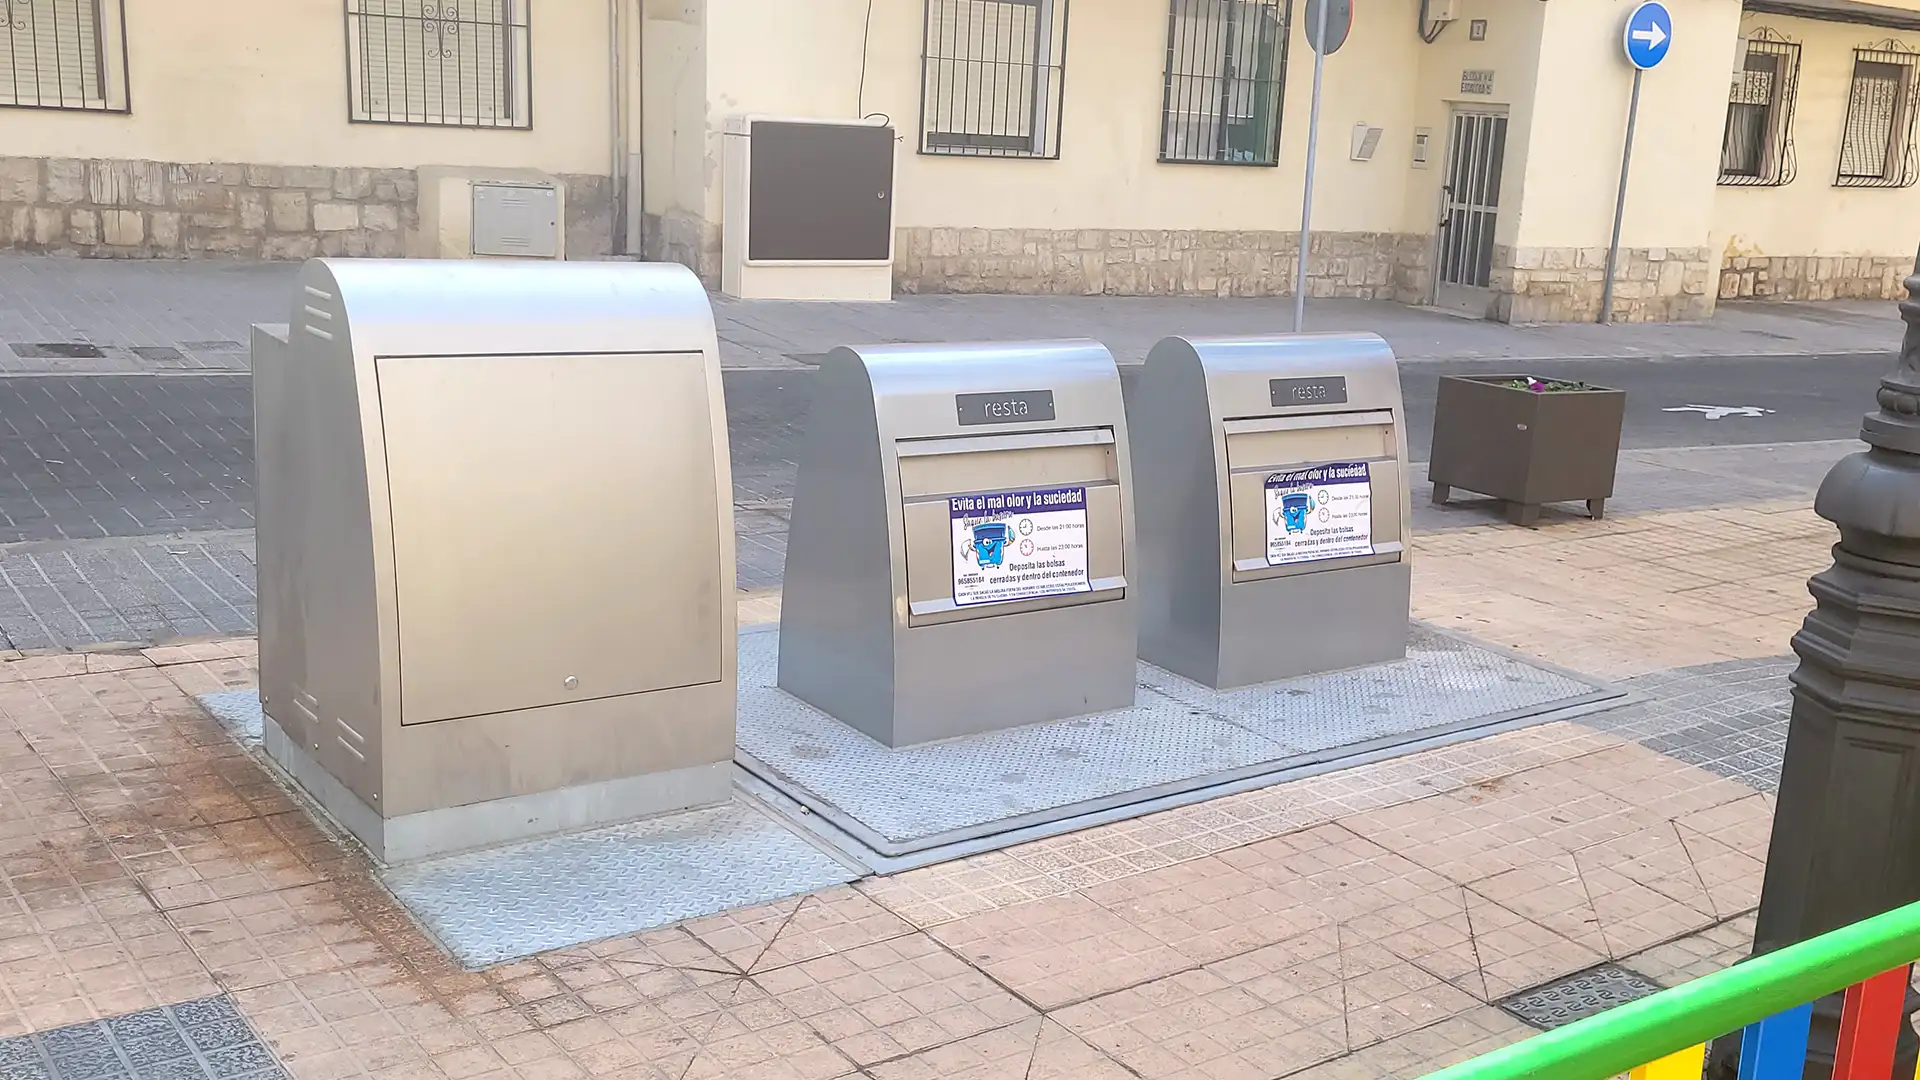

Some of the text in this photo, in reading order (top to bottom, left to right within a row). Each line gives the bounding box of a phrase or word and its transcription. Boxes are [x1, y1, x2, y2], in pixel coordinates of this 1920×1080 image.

[1292, 385, 1326, 400] resta
[985, 399, 1028, 417] resta
[1308, 468, 1322, 480] olor
[1323, 469, 1328, 482] y
[1328, 466, 1336, 478] la
[1336, 463, 1367, 478] suciedad
[952, 489, 1082, 511] Evita el mal olor y la suciedad
[1310, 528, 1330, 536] Deposita
[1009, 559, 1066, 572] Deposita las bolsas
[989, 573, 1017, 583] cerradas
[1016, 574, 1021, 583] y
[1021, 572, 1041, 581] dentro
[1041, 570, 1052, 579] del
[1052, 568, 1084, 578] contenedor
